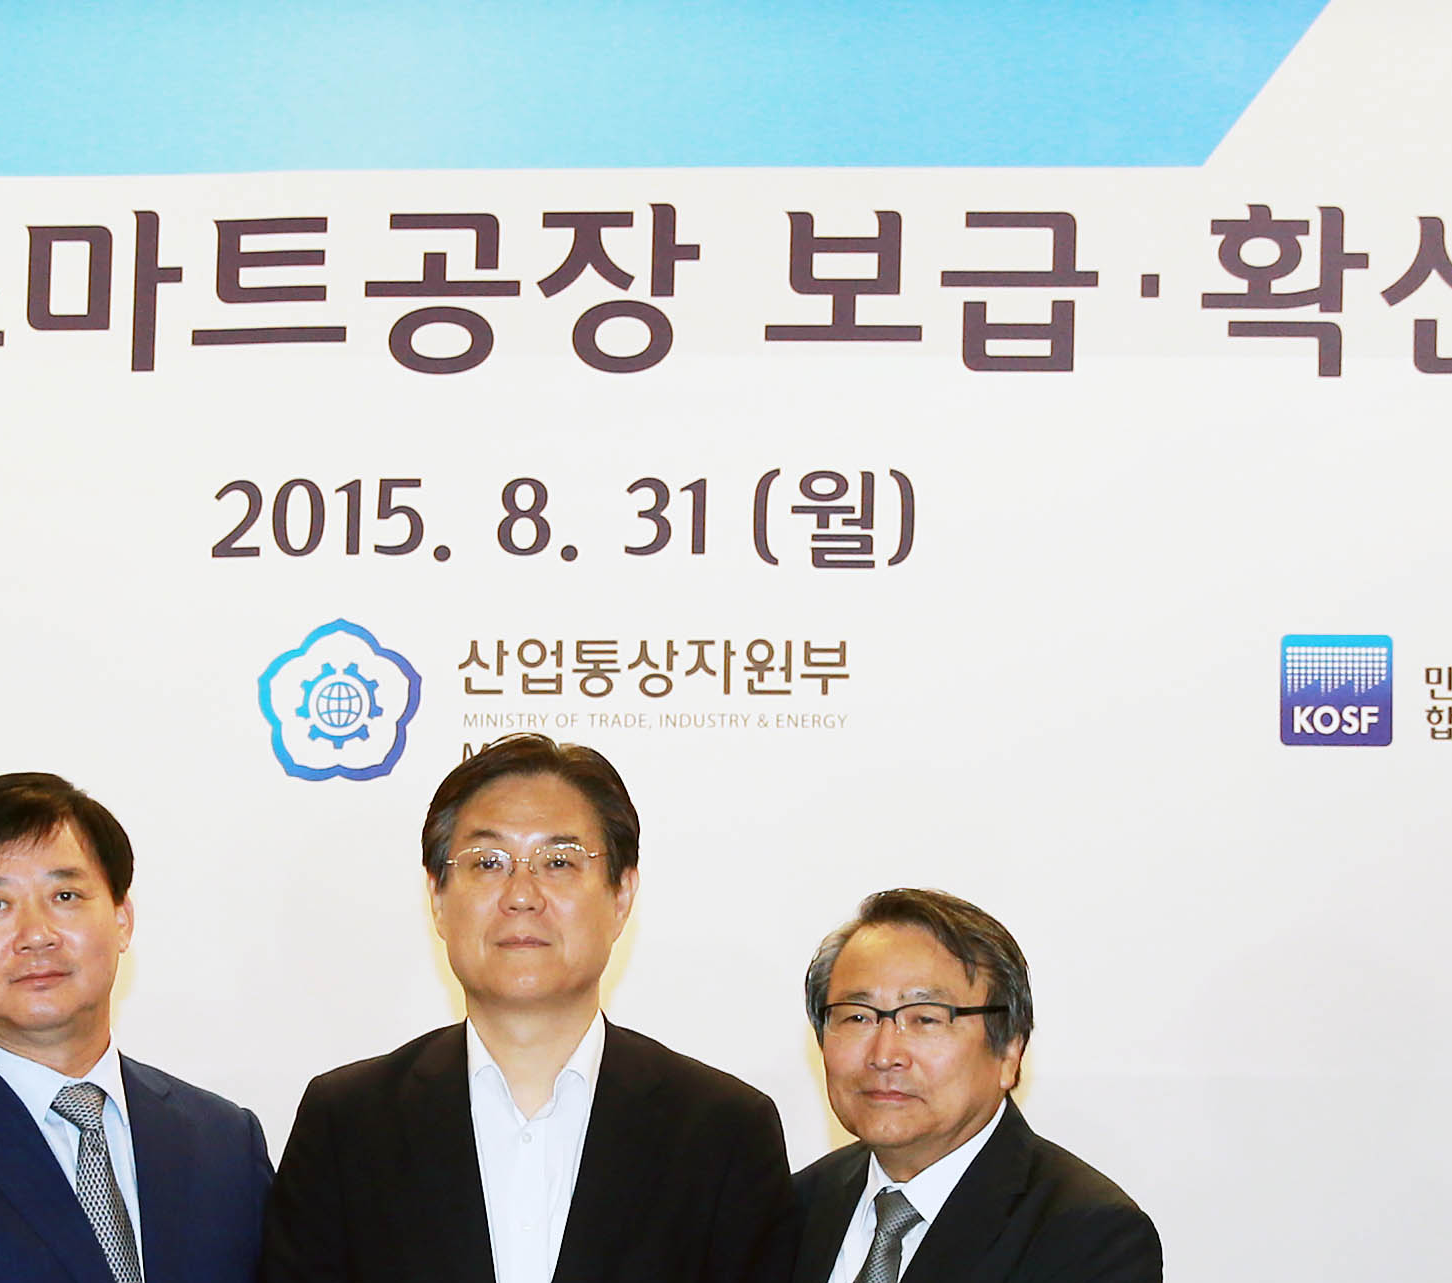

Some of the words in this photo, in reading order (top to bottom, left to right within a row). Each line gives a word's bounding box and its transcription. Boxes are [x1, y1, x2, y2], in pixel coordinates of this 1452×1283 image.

[212, 479, 450, 561] 2015.
[498, 478, 578, 561] 8.
[625, 478, 706, 555] 31
[754, 469, 914, 568] (월)
[458, 639, 850, 698] 산업통상자원부
[463, 713, 549, 729] MINISTRY
[555, 713, 579, 729] OF
[587, 713, 652, 731] TRADE,
[659, 713, 751, 729] INDUSTRY
[757, 713, 769, 729] &
[776, 713, 848, 729] ENERGY
[1293, 706, 1380, 735] KOSF
